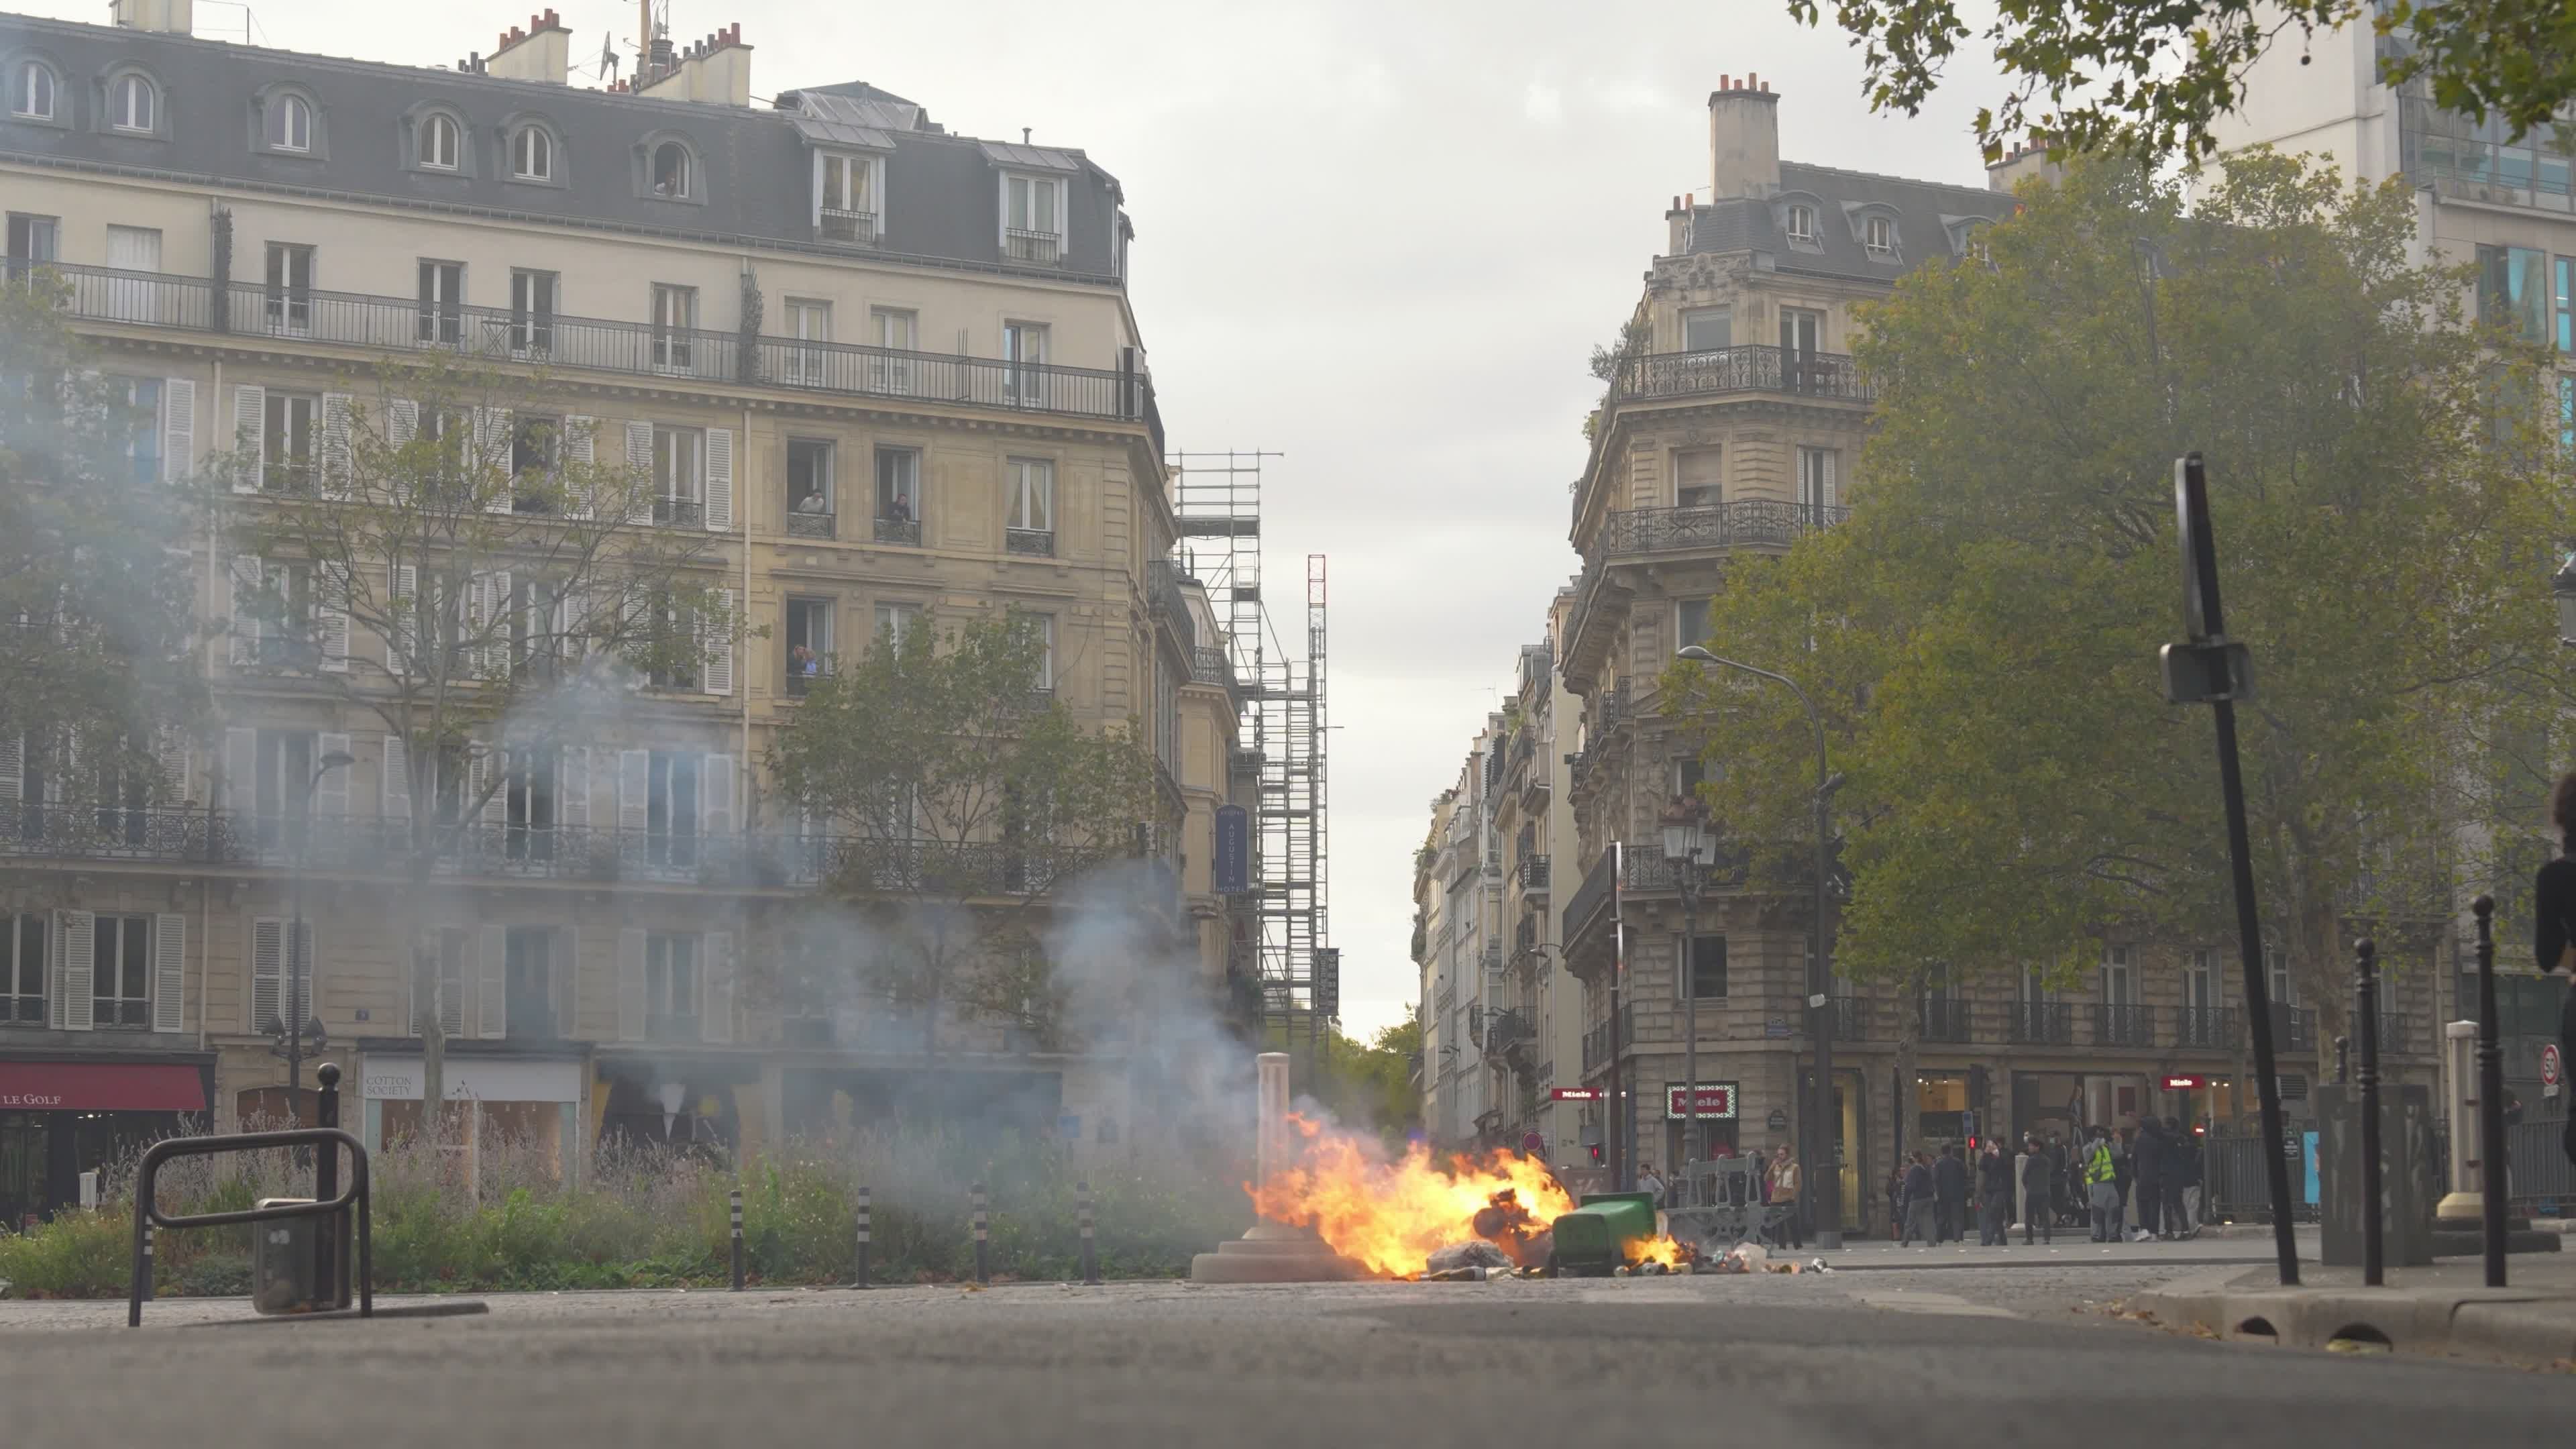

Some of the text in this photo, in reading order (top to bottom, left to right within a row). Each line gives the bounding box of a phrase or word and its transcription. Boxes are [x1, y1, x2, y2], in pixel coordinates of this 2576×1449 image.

[2545, 1058, 2555, 1073] 50
[366, 1075, 413, 1085] COTTON
[366, 1086, 411, 1095] SOCIETY
[3, 1095, 21, 1104] LE
[1677, 1097, 1721, 1106] Mele
